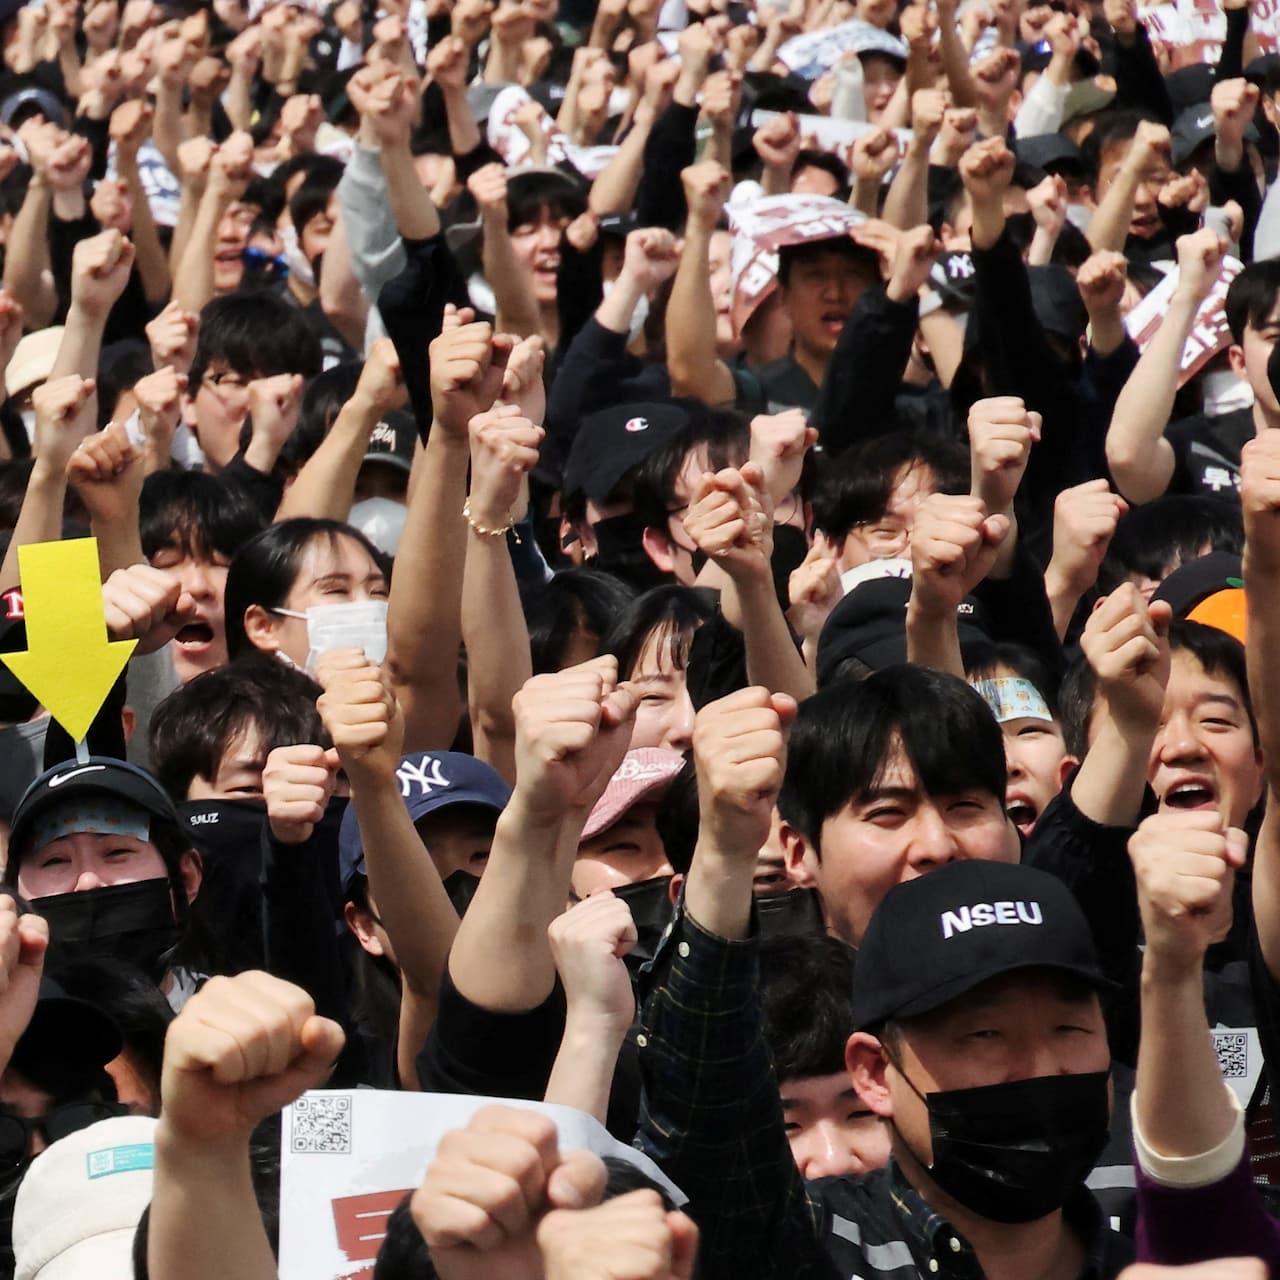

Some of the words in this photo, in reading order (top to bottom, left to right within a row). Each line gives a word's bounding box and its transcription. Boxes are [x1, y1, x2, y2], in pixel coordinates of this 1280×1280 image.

[1202, 465, 1242, 492] 투
[395, 755, 450, 798] NY
[941, 901, 1043, 940] NSEU
